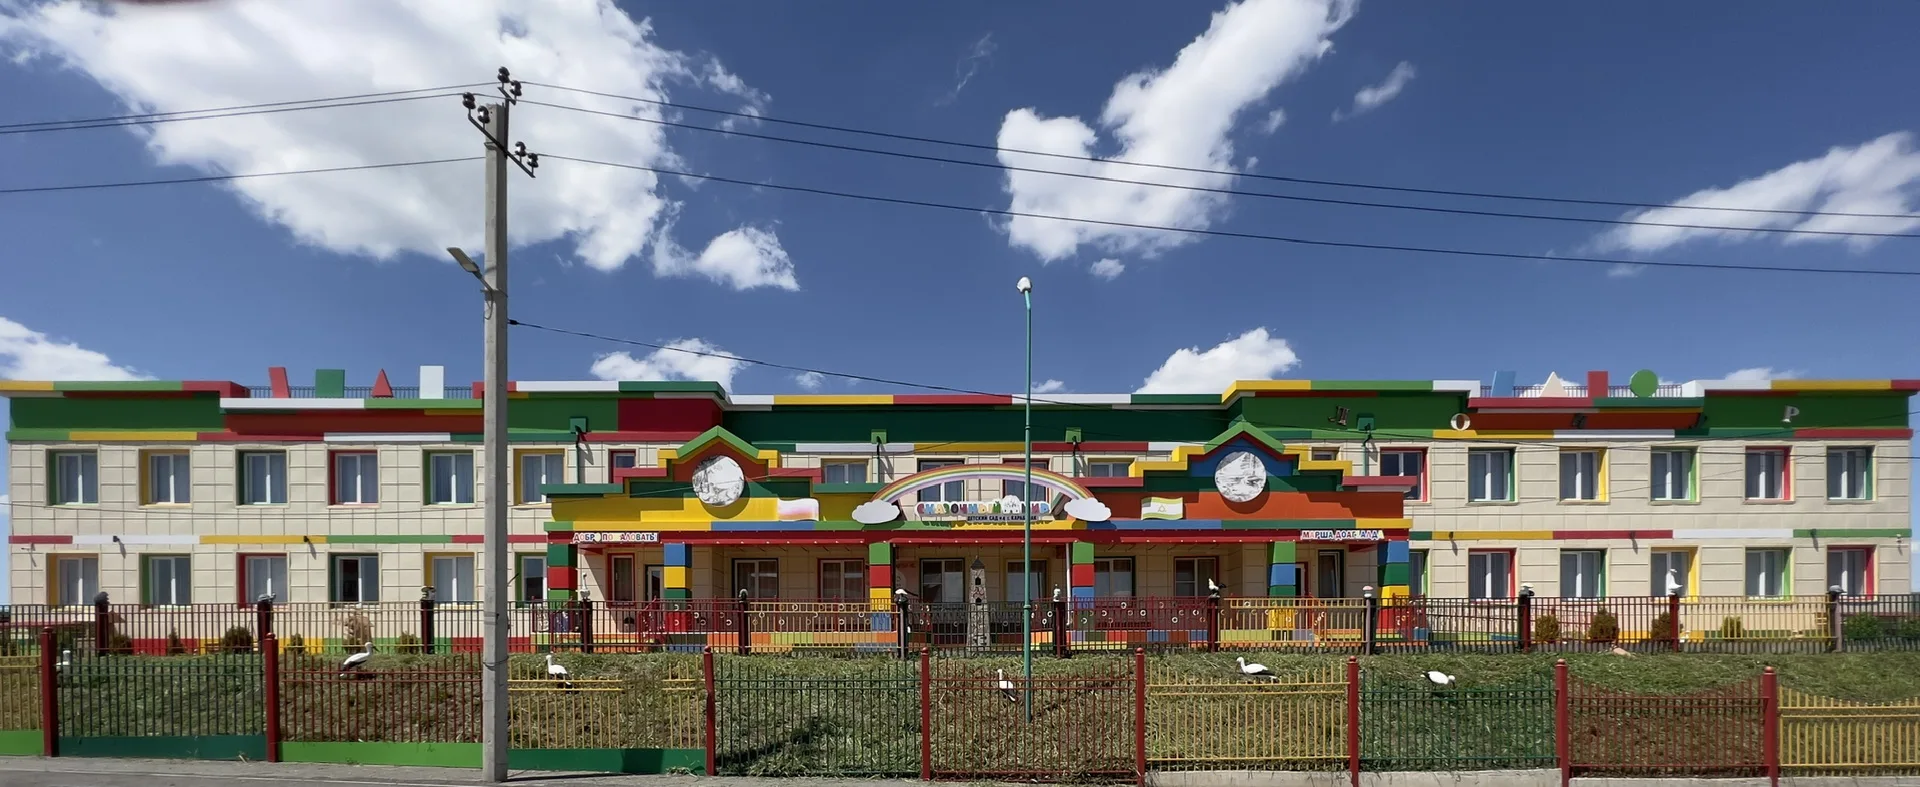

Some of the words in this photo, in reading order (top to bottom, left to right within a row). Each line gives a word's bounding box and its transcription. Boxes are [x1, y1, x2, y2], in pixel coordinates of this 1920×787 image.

[917, 501, 1001, 514] СКАЗОЧНЫЙ
[602, 533, 657, 541] ПОАЛОВАТЬ!
[1302, 530, 1334, 539] МАРША
